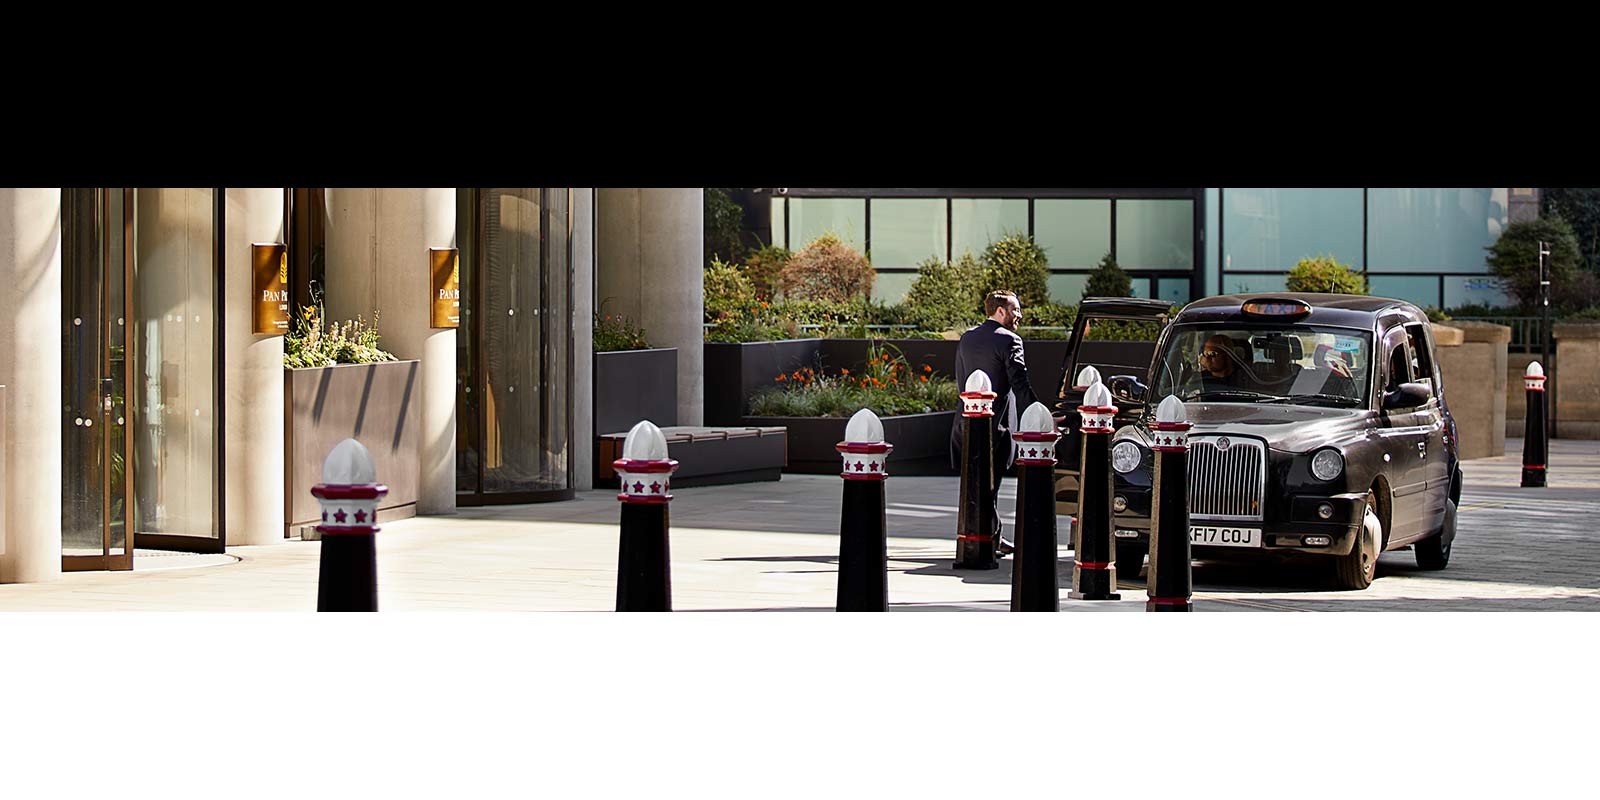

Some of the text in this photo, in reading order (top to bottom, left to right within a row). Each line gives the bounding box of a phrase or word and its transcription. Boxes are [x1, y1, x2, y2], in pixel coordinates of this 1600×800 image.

[263, 290, 280, 301] PAN
[439, 289, 454, 300] PAN
[1256, 304, 1297, 314] TAXI
[1221, 529, 1251, 543] COJ
